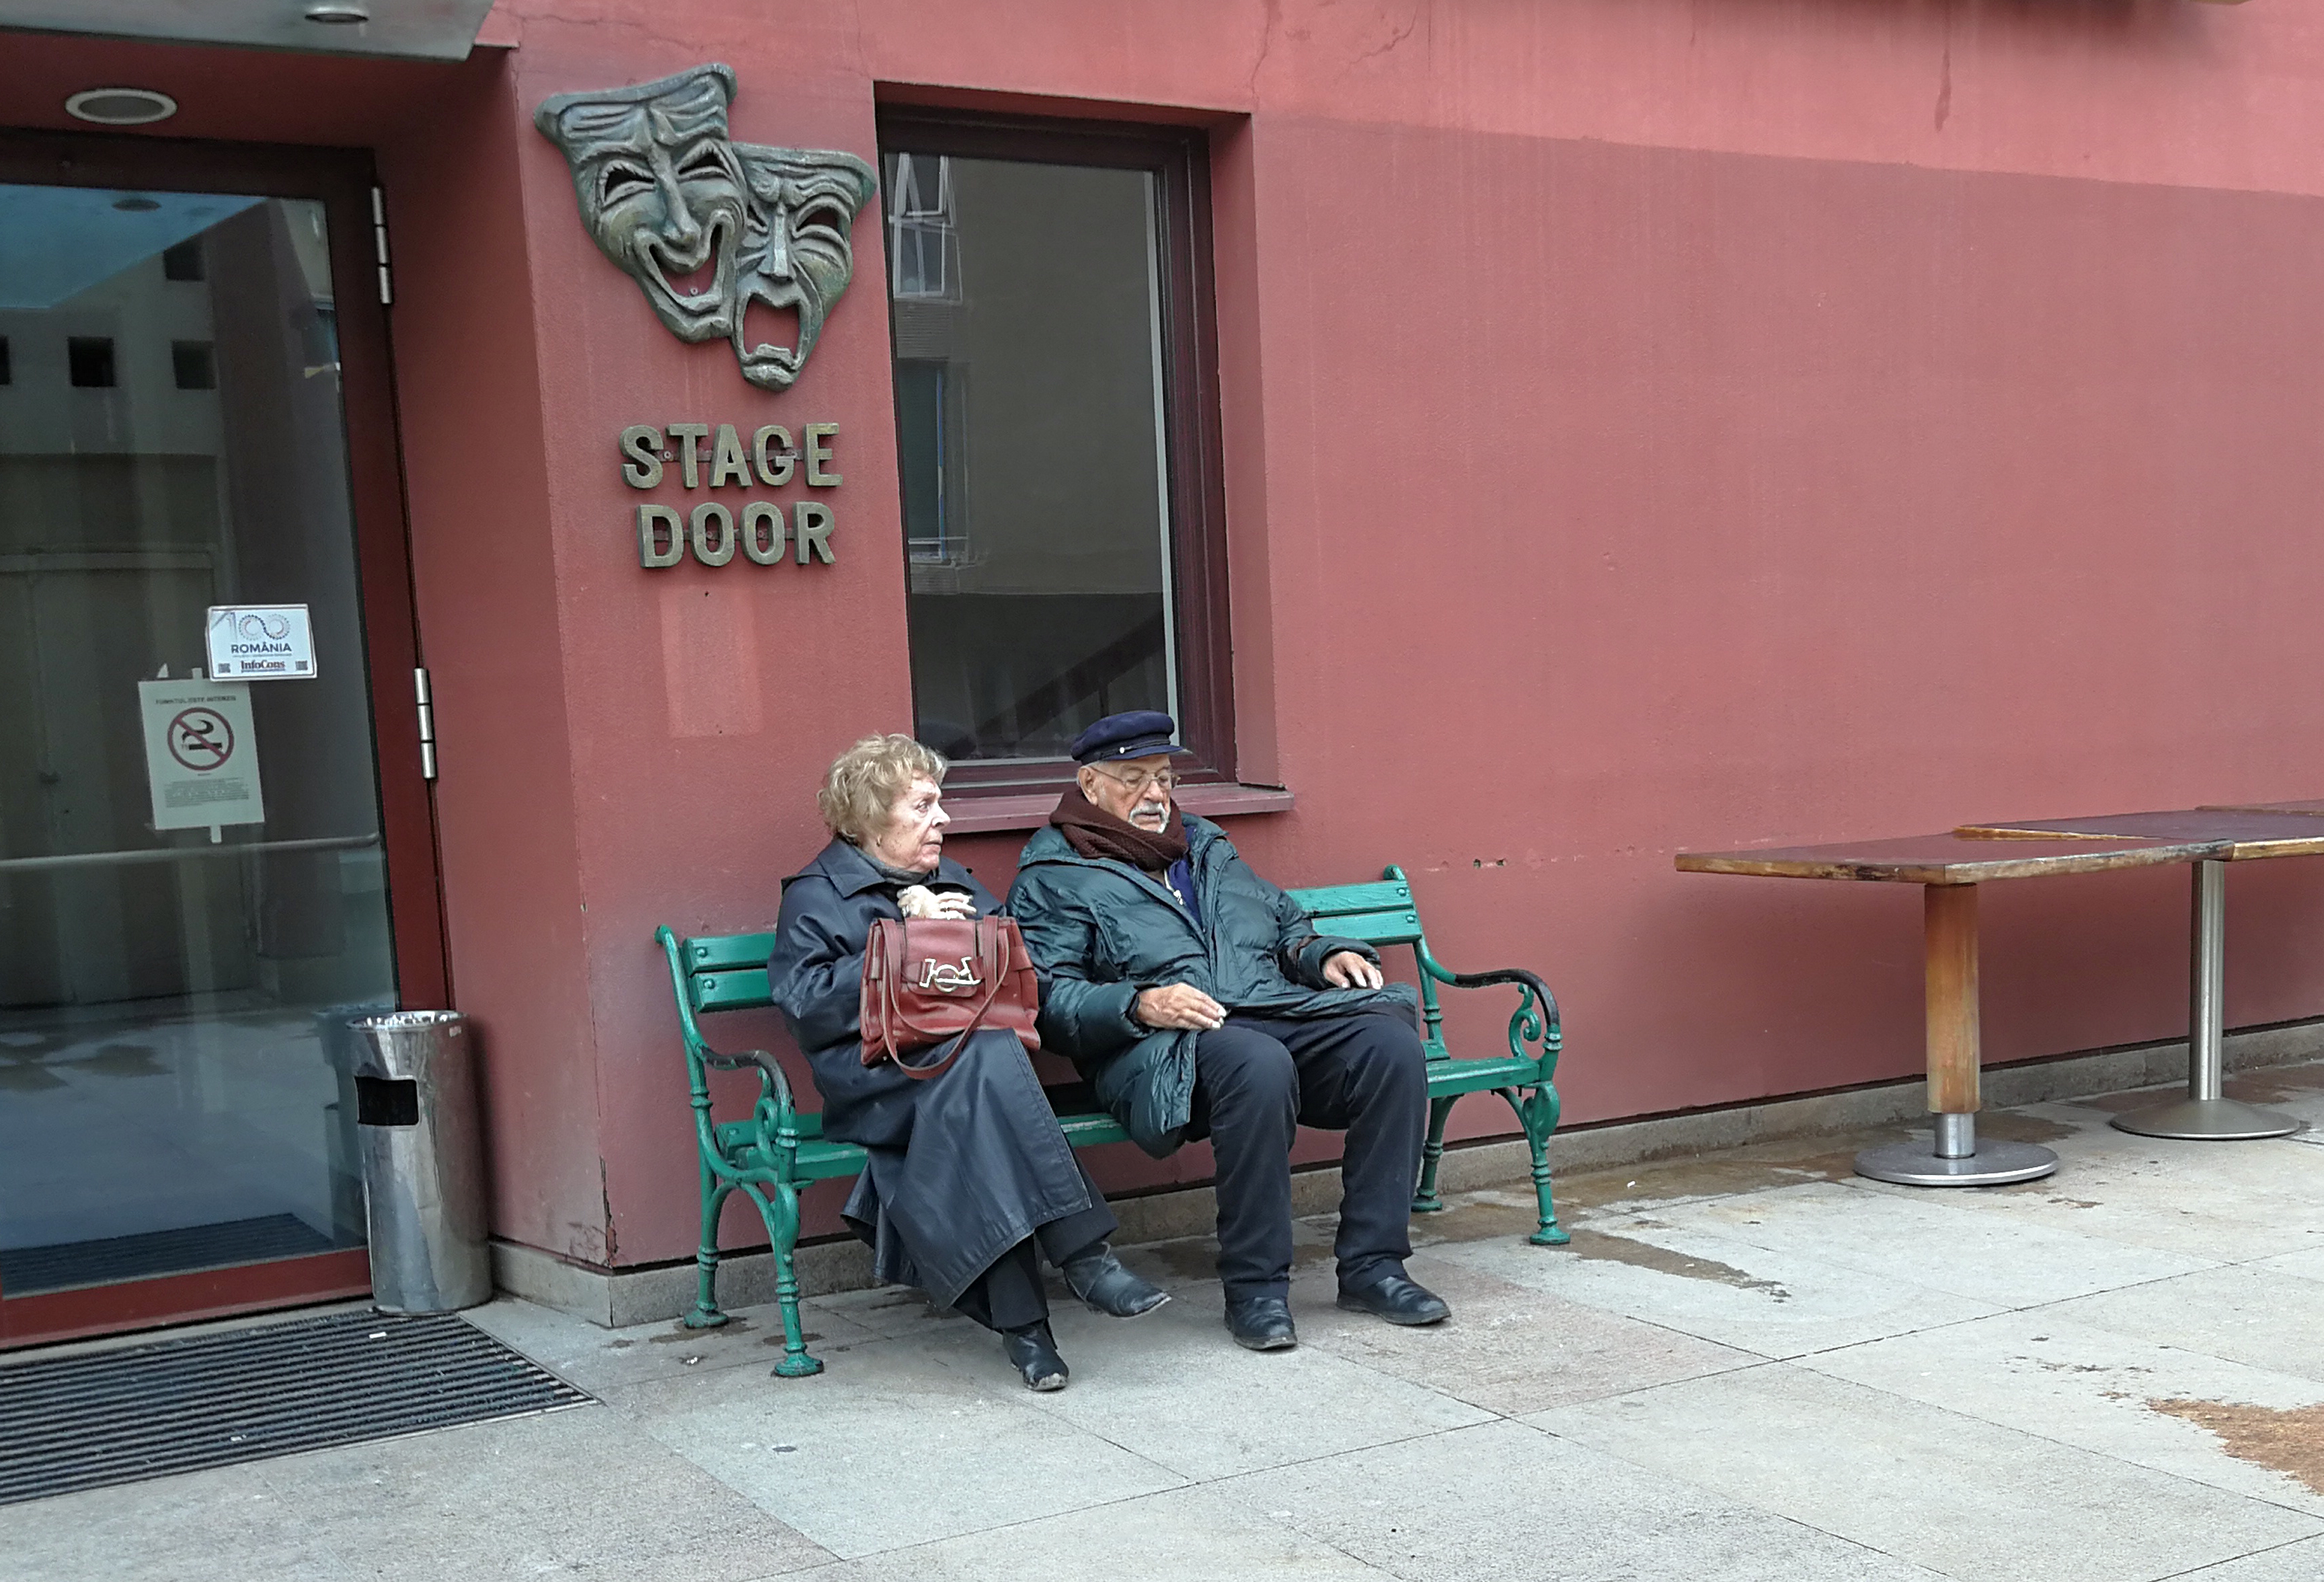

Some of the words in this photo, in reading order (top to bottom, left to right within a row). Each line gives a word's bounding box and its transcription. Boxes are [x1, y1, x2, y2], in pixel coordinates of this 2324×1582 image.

[619, 422, 844, 489] STAGE
[636, 501, 837, 568] DOOR
[231, 641, 292, 654] ROMÂNIA
[241, 660, 285, 669] InfoCons
